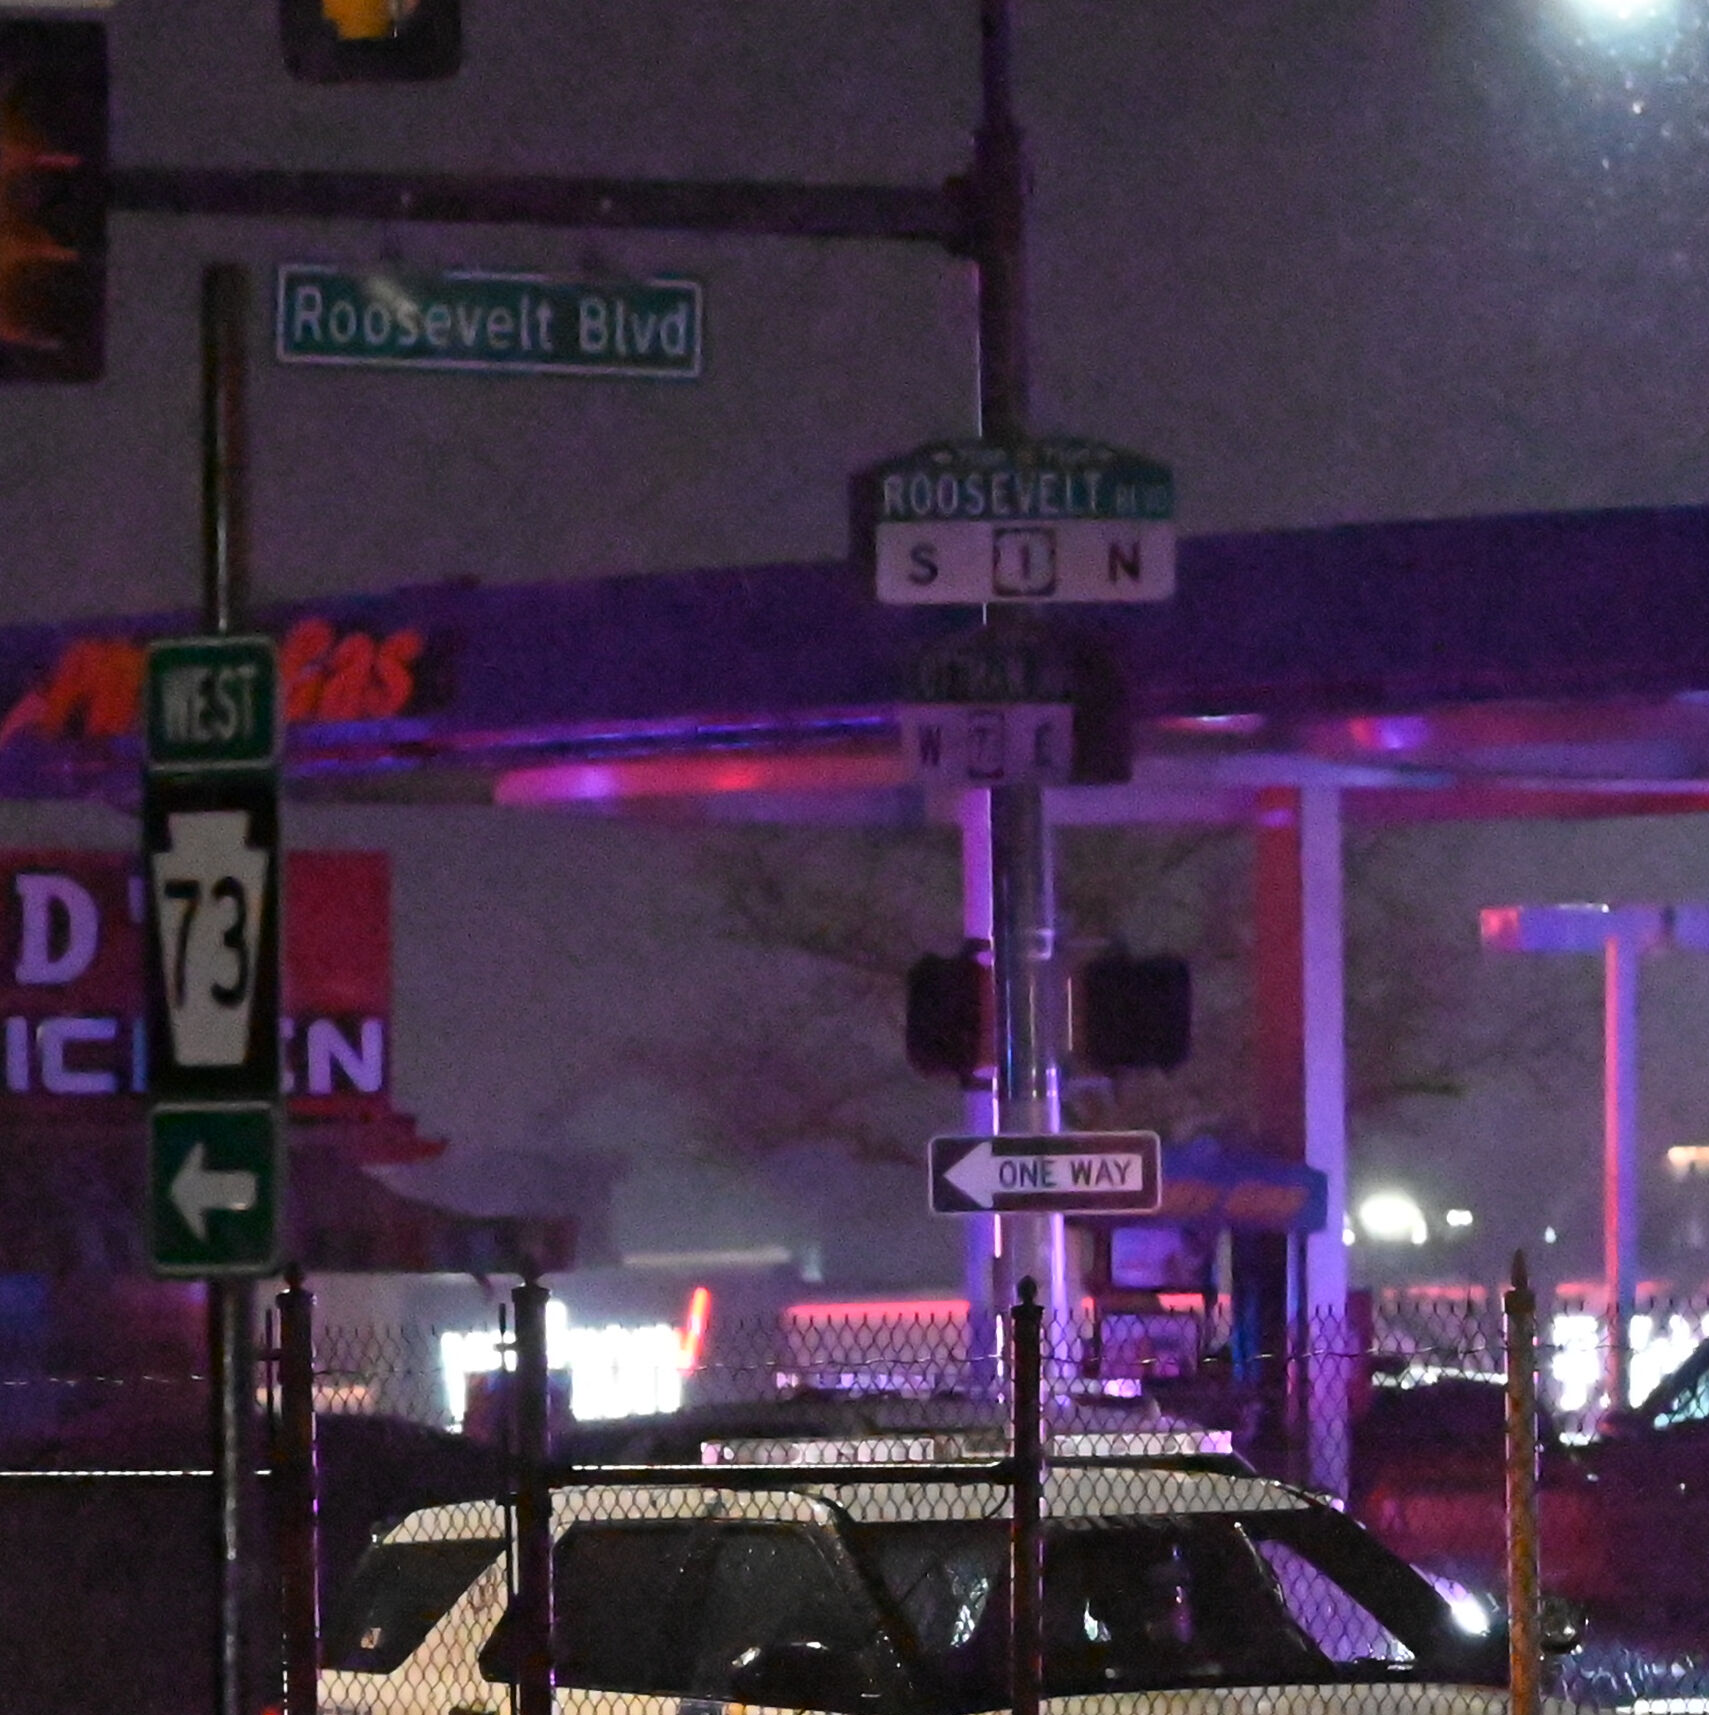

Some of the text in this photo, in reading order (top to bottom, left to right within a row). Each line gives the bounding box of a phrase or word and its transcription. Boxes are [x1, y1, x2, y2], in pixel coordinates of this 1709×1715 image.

[293, 285, 687, 357] Roosevelt Blvd
[883, 472, 1101, 516] ROOSEVELT
[908, 543, 938, 587] S
[1106, 542, 1140, 583] N
[162, 664, 256, 744] WEST
[163, 874, 251, 1008] 73
[999, 1159, 1131, 1188] ONE WAY
